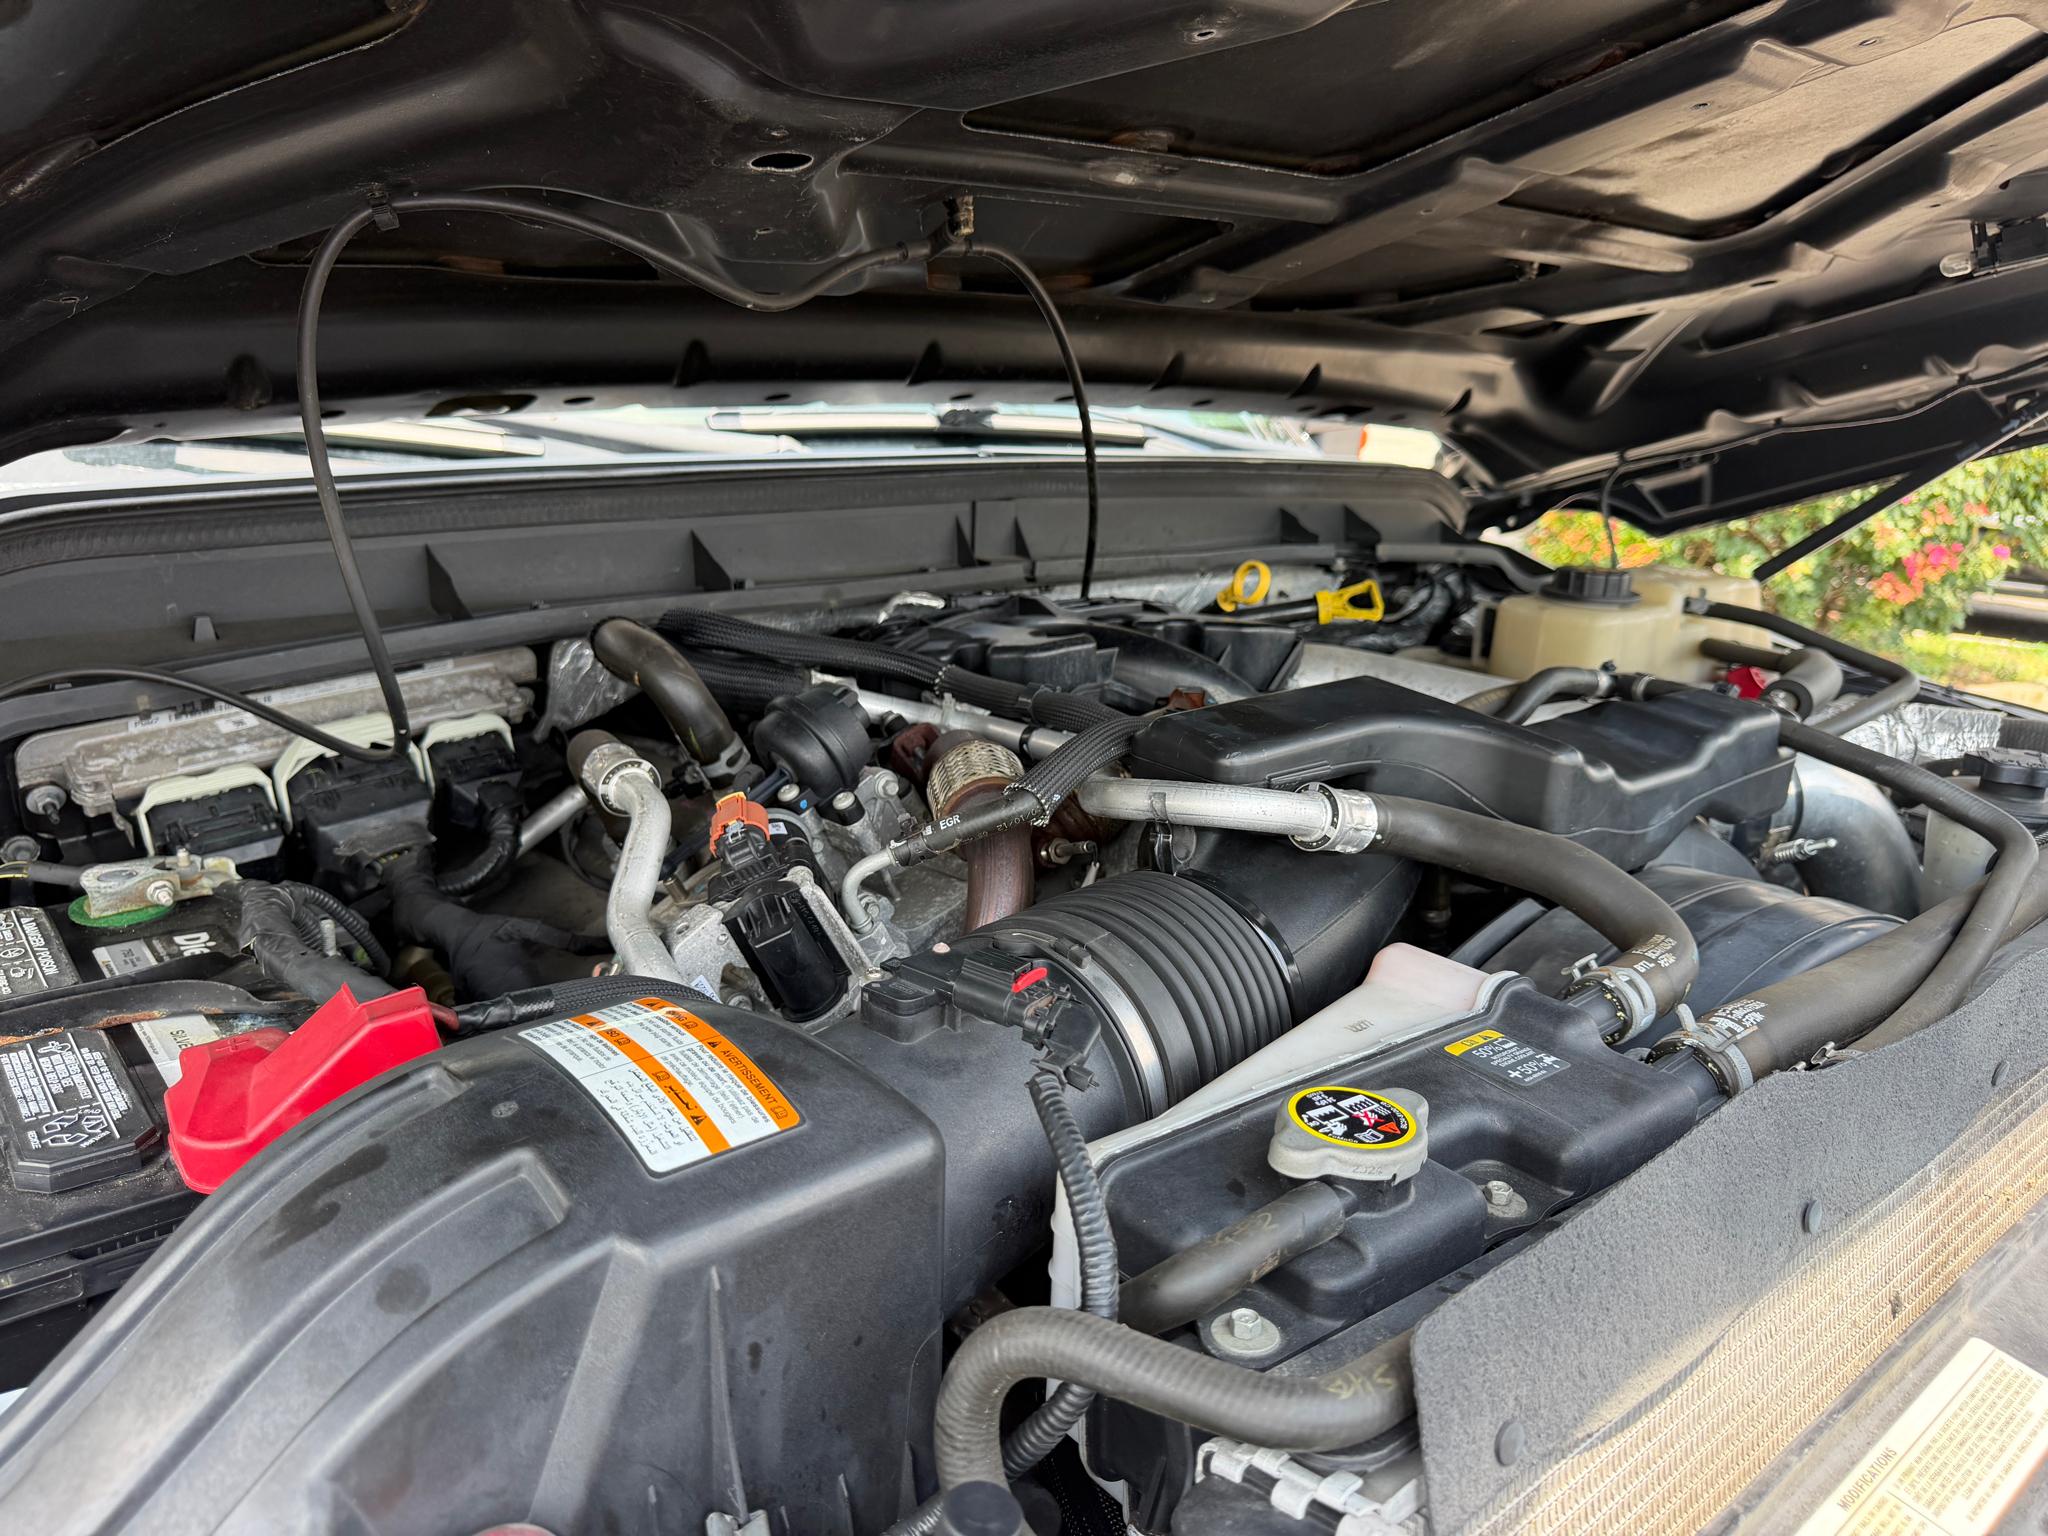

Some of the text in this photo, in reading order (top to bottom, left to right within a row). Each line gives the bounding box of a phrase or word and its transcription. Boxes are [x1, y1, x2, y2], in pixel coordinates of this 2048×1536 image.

[939, 814, 960, 830] EGR
[22, 921, 46, 947] DANGER
[35, 950, 59, 975] POISON
[171, 1029, 193, 1049] SILVE
[1472, 1044, 1503, 1058] 50%
[720, 1050, 778, 1105] AVERTISSEMENT
[1836, 1447, 1897, 1512] MODIFICATIONS
